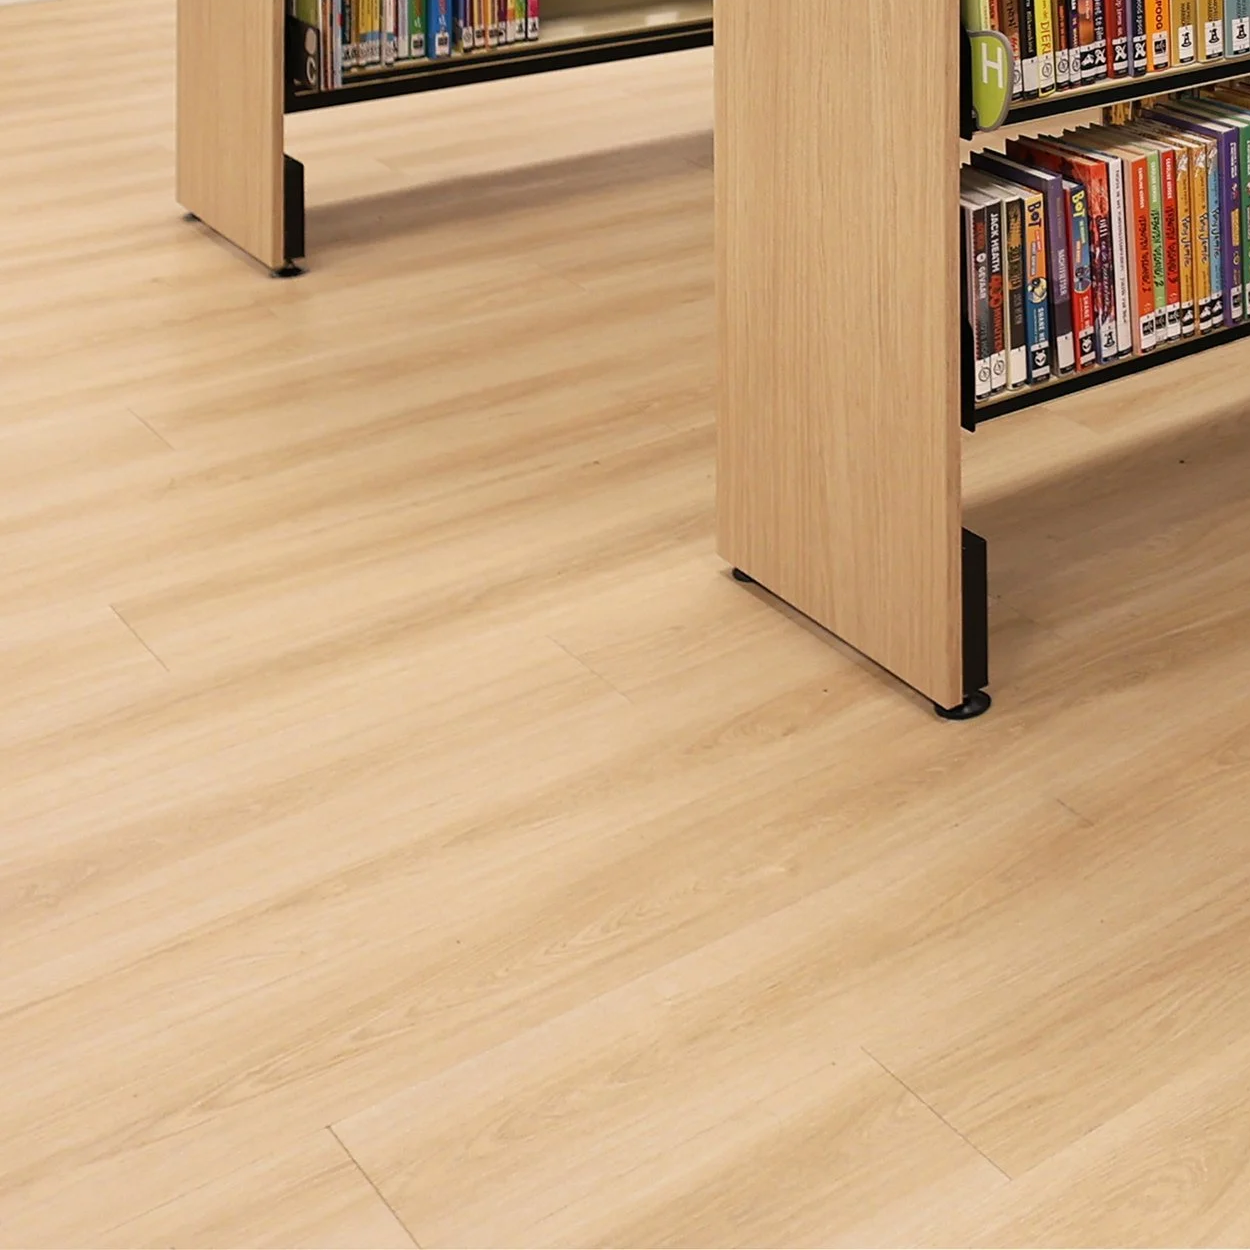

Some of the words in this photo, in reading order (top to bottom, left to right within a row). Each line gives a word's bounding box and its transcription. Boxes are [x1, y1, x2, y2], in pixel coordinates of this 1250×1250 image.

[981, 42, 1004, 89] H
[1027, 201, 1042, 228] BOT
[1071, 190, 1085, 218] BOT
[990, 213, 998, 236] JACK
[991, 239, 1000, 272] HEATH
[978, 266, 986, 299] GEVAAR
